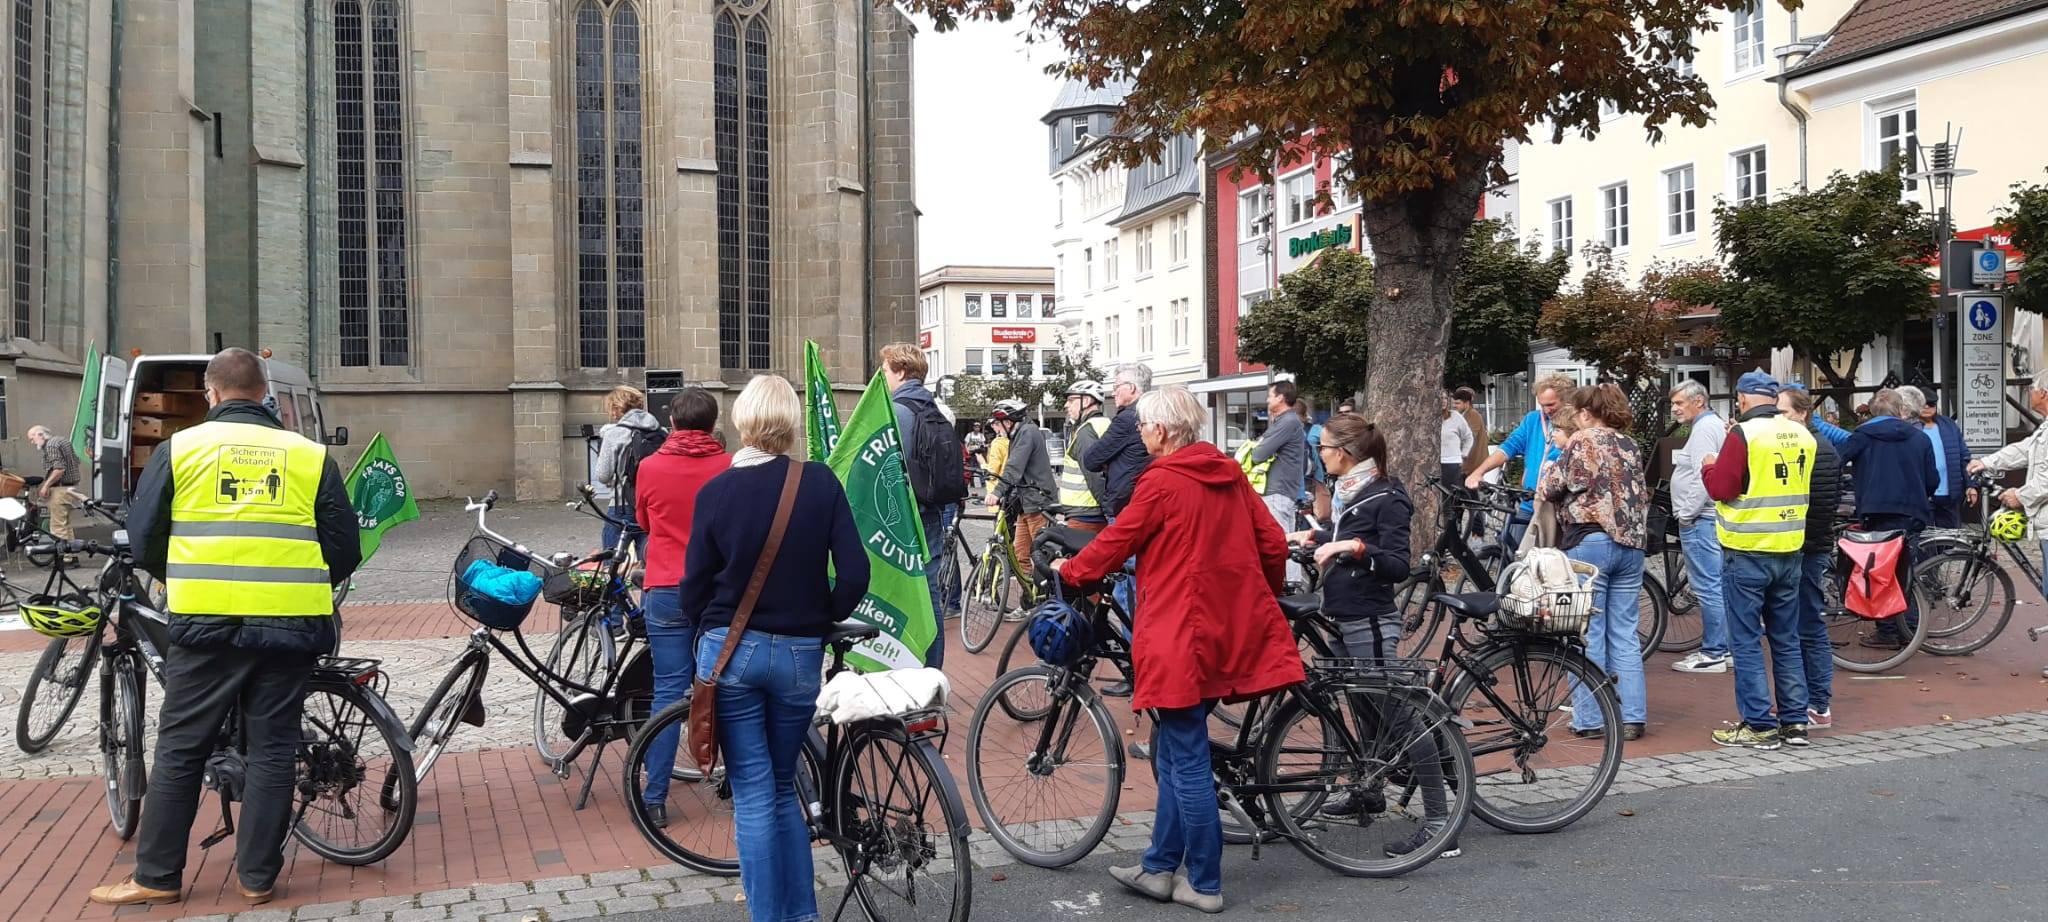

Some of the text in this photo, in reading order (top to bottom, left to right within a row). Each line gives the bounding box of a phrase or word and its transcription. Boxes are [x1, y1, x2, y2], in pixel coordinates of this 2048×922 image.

[1972, 333, 1993, 341] ZONE
[230, 447, 276, 457] Sicher mit
[231, 457, 274, 466] Abstand!
[393, 475, 405, 498] FOR
[241, 487, 254, 496] 1,5
[854, 598, 897, 633] iken,
